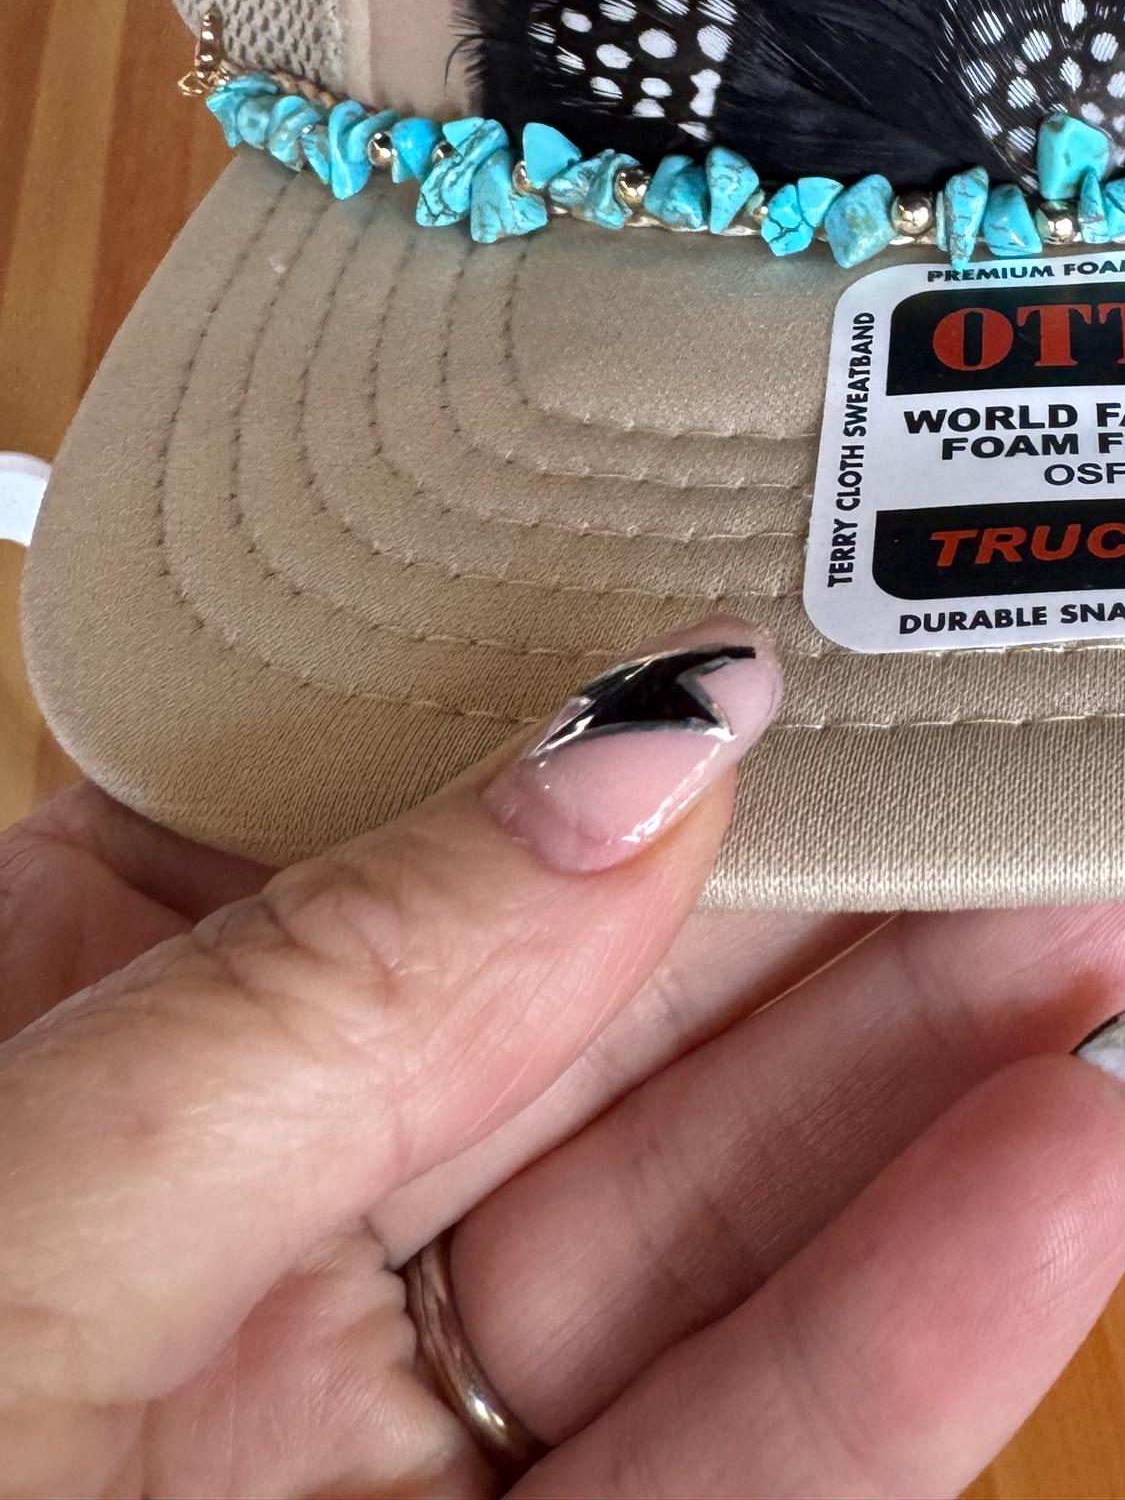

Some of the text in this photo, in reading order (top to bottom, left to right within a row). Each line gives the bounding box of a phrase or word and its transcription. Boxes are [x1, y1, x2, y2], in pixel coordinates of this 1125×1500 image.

[927, 265, 1056, 283] PREMIUM
[903, 404, 1078, 434] WORLD
[827, 312, 875, 588] TERRY CLOTH SWEATBAND
[941, 433, 1079, 461] FOAM
[899, 605, 1048, 635] DURABLE
